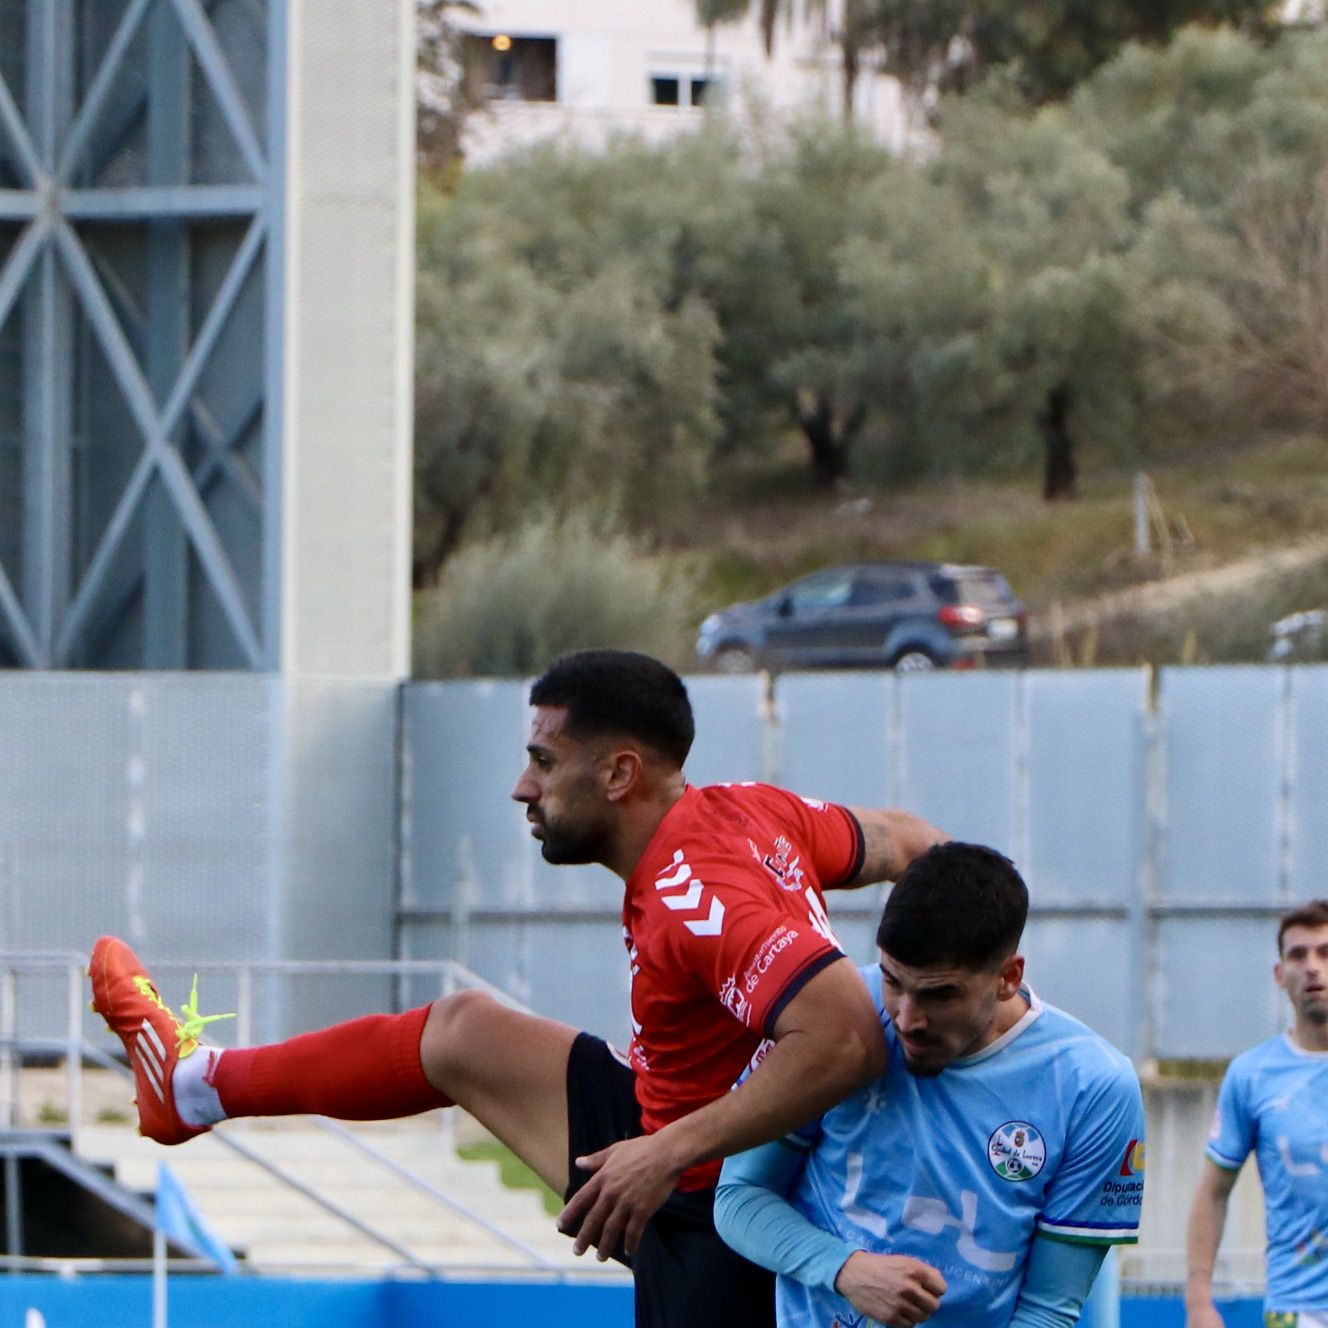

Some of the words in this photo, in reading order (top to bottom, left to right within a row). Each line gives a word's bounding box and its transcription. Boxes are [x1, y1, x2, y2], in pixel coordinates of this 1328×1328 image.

[746, 975, 759, 993] de
[757, 930, 799, 974] Cartaya
[1101, 1195, 1114, 1206] de
